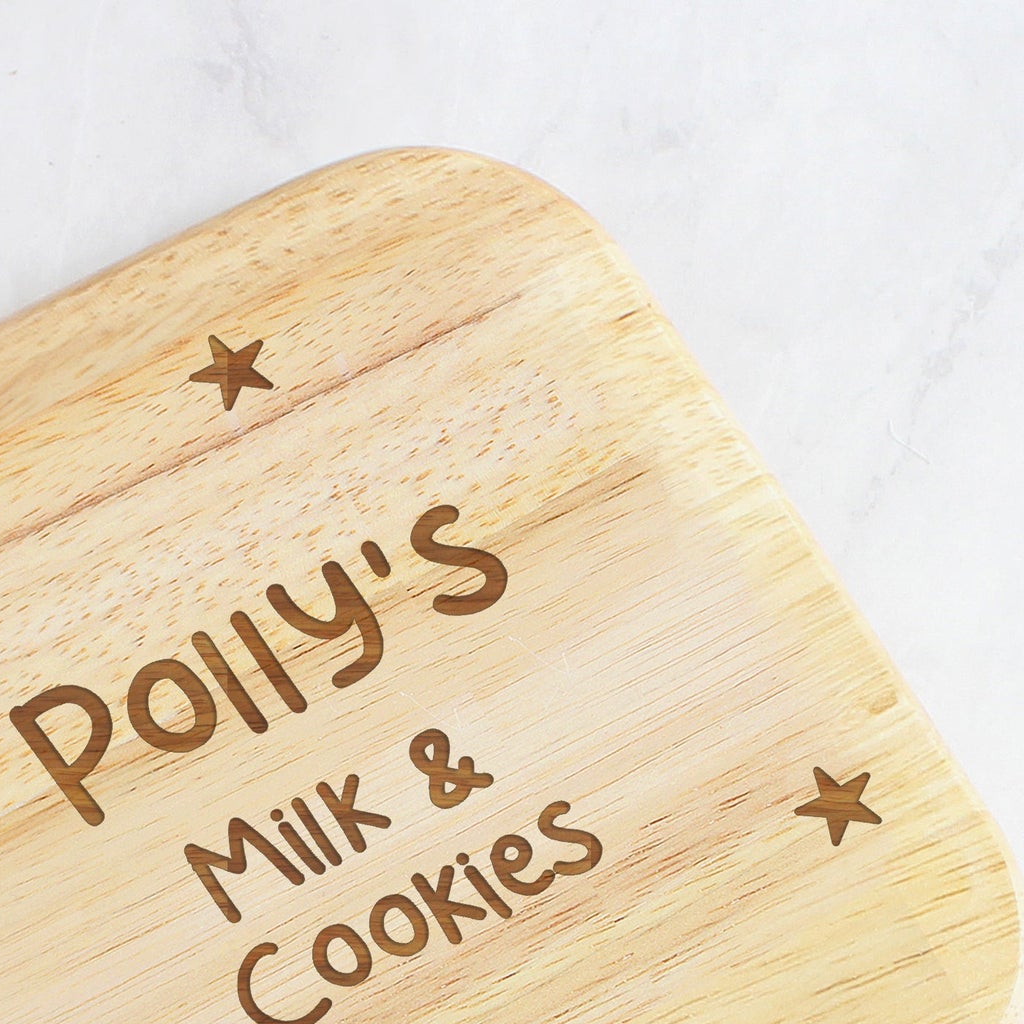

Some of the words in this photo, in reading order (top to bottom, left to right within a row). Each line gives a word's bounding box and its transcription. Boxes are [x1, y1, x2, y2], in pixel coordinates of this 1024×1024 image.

[9, 505, 508, 826] Polly's
[183, 773, 392, 924] Milk
[409, 728, 495, 810] &
